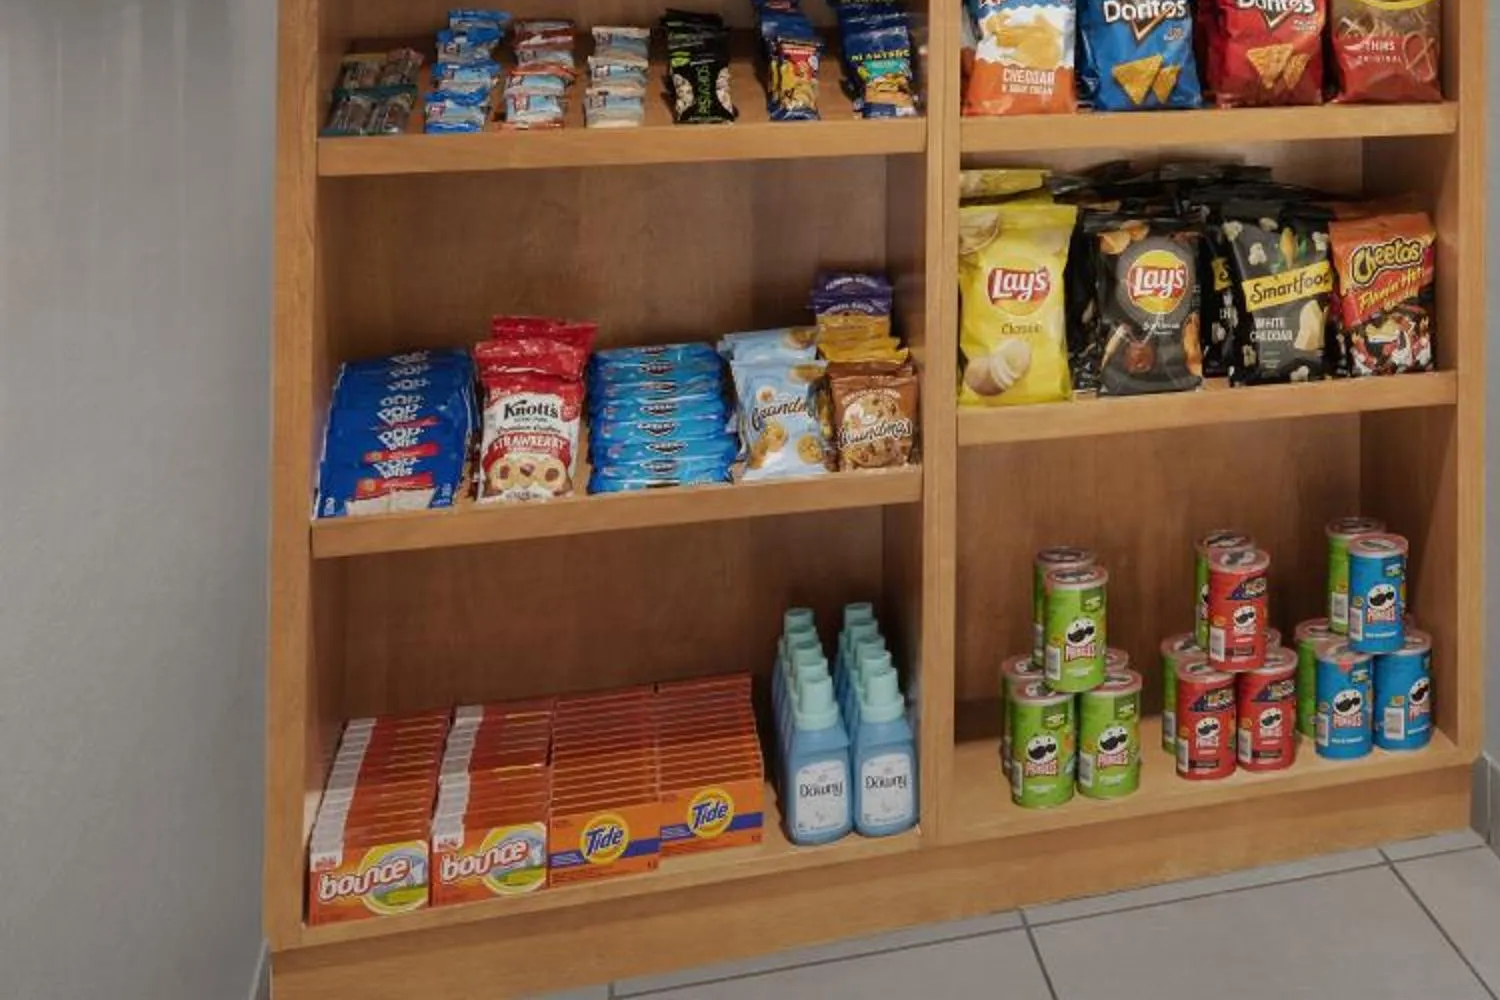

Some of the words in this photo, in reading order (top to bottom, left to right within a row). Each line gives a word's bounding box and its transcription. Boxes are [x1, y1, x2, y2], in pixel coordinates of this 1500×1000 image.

[1003, 67, 1055, 85] CHEDDAR
[1352, 240, 1421, 284] Cheetos
[991, 266, 1050, 300] Lay's
[1134, 266, 1187, 298] Lay's
[1250, 329, 1293, 341] CHEDDAR
[1256, 317, 1285, 329] WHITE
[504, 399, 559, 420] Knott's
[800, 782, 844, 798] Downy
[865, 775, 908, 790] Downy
[692, 801, 729, 830] Tide
[586, 825, 624, 857] Tide
[440, 839, 529, 885] bounce
[319, 856, 411, 904] bounce
